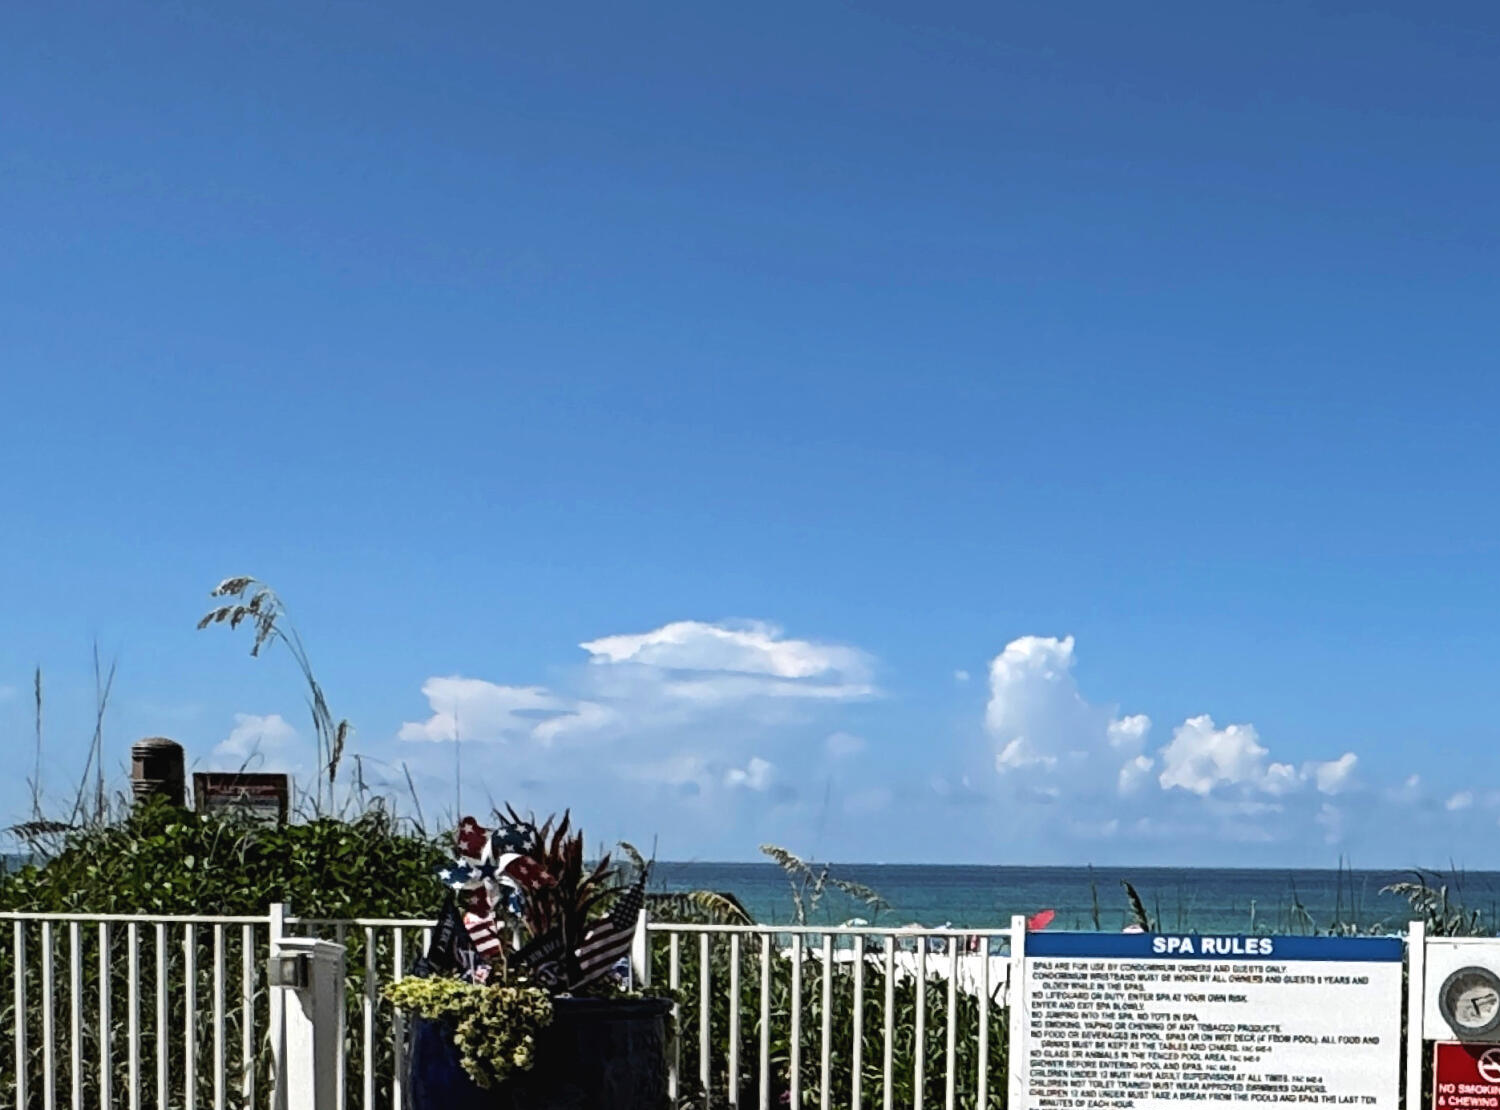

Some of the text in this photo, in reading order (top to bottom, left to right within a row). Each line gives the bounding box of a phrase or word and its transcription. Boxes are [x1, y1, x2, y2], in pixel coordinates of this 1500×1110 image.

[1152, 937, 1274, 955] SPA RULES
[1439, 1083, 1456, 1093] NO
[1448, 1096, 1499, 1107] CHEWING
